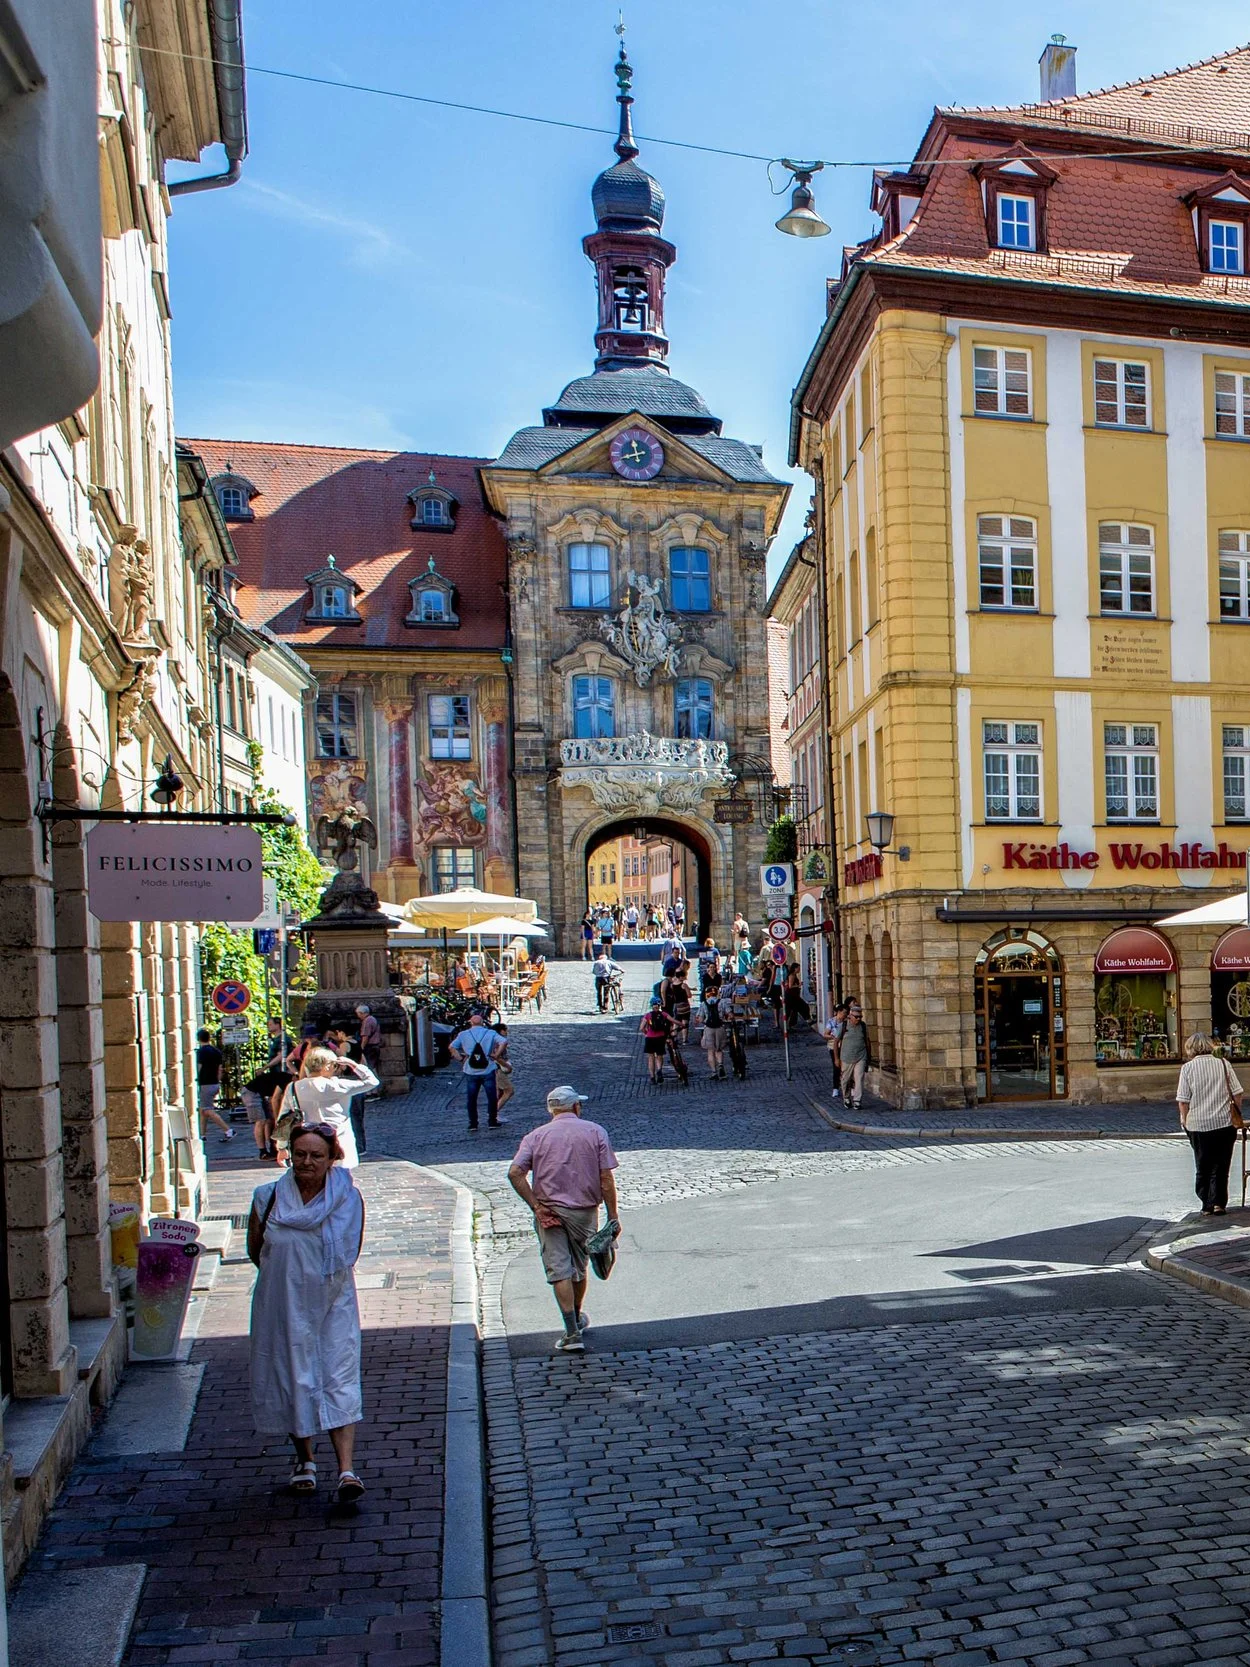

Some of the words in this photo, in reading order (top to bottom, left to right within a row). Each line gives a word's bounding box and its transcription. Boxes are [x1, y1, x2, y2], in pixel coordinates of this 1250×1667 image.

[1002, 842, 1100, 870] Käthe
[1108, 842, 1248, 870] Wohlfahr
[99, 856, 254, 873] FELICISSIMO
[172, 879, 214, 889] Lifestyle.
[1104, 959, 1126, 967] Käthe
[1221, 956, 1242, 964] Käthe
[153, 1221, 197, 1235] Zitronen
[161, 1231, 187, 1241] Soda
